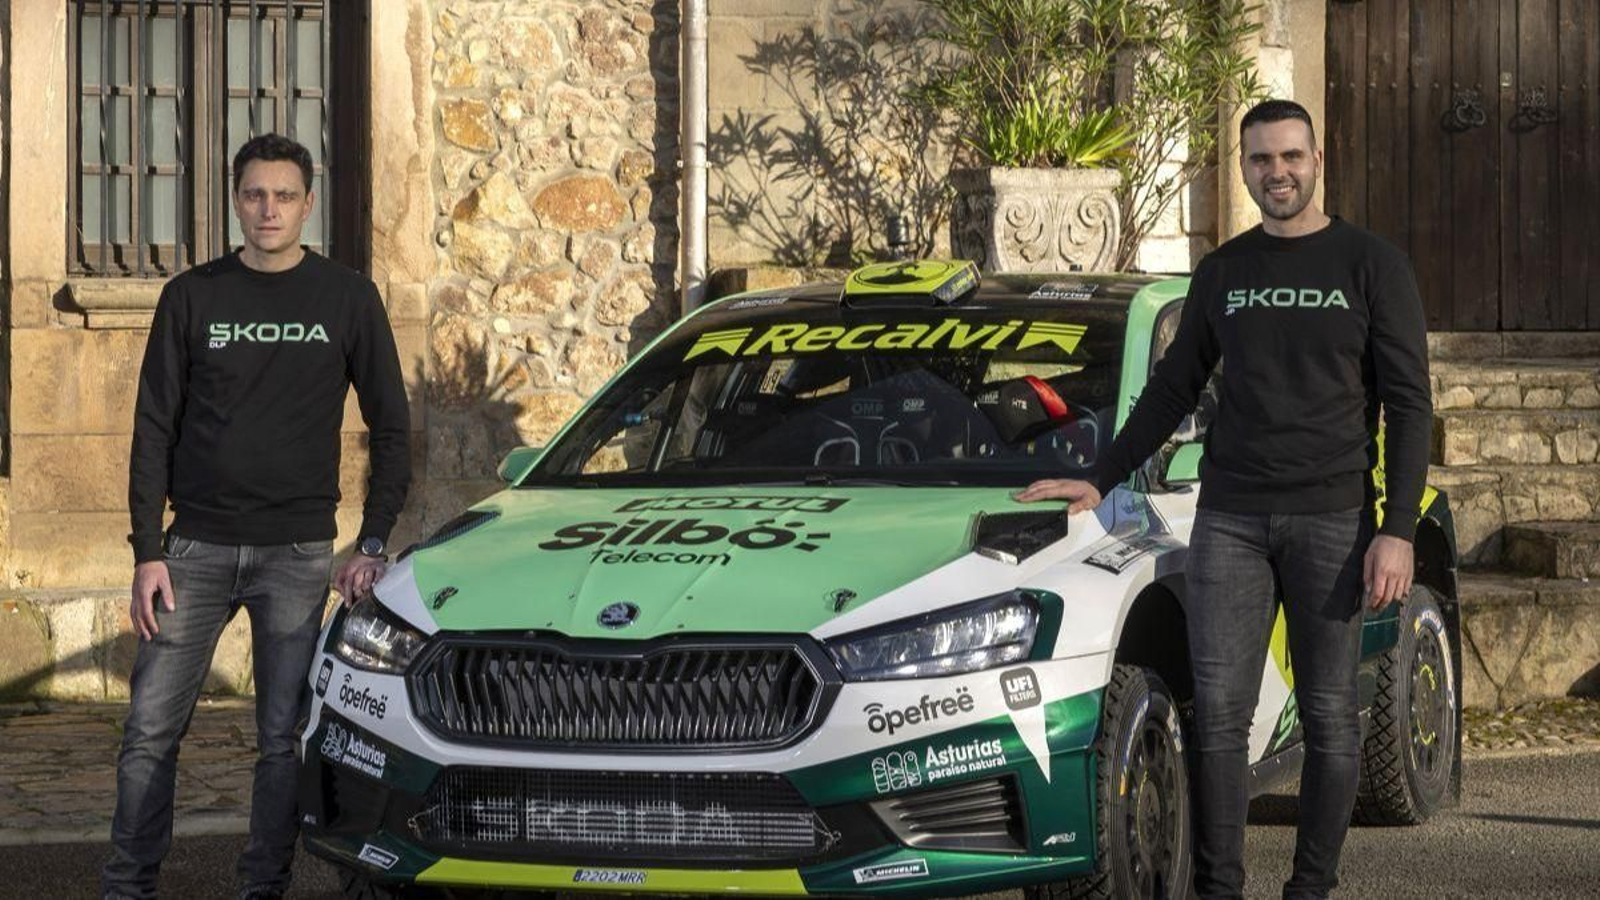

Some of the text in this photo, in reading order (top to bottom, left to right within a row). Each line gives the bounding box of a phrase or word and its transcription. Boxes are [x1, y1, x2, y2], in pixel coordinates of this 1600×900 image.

[208, 341, 227, 349] DLP
[744, 318, 1024, 357] Recalvi
[851, 402, 884, 415] OMP
[589, 549, 731, 566] Telecom
[1005, 674, 1034, 694] UFI
[346, 732, 386, 768] Asturias
[925, 739, 1003, 768] Asturias
[969, 755, 1007, 772] natural
[876, 864, 920, 877] MICHELIN
